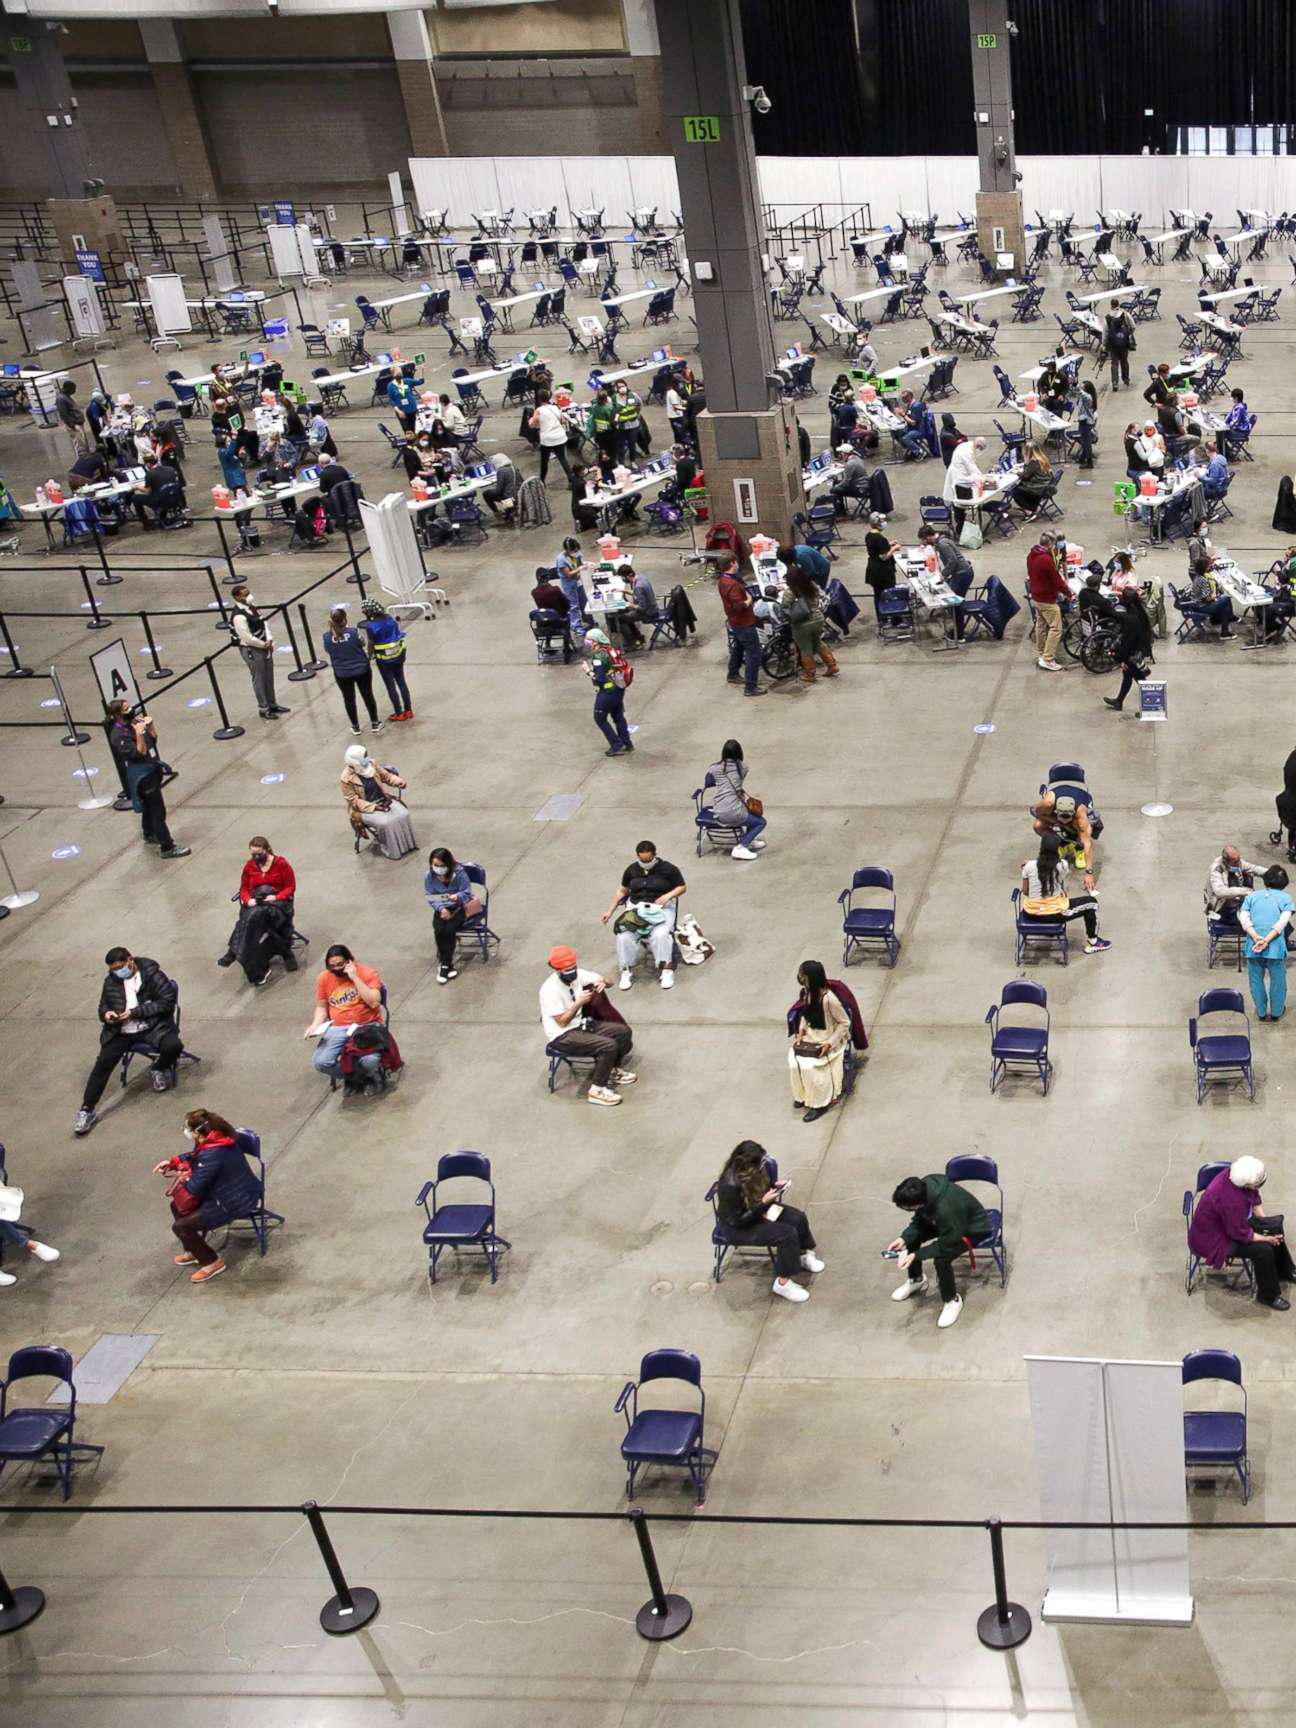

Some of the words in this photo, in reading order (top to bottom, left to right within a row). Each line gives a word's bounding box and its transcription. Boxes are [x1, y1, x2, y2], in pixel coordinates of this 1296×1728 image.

[979, 36, 995, 47] 15P
[689, 119, 718, 140] 15L
[111, 668, 128, 698] A
